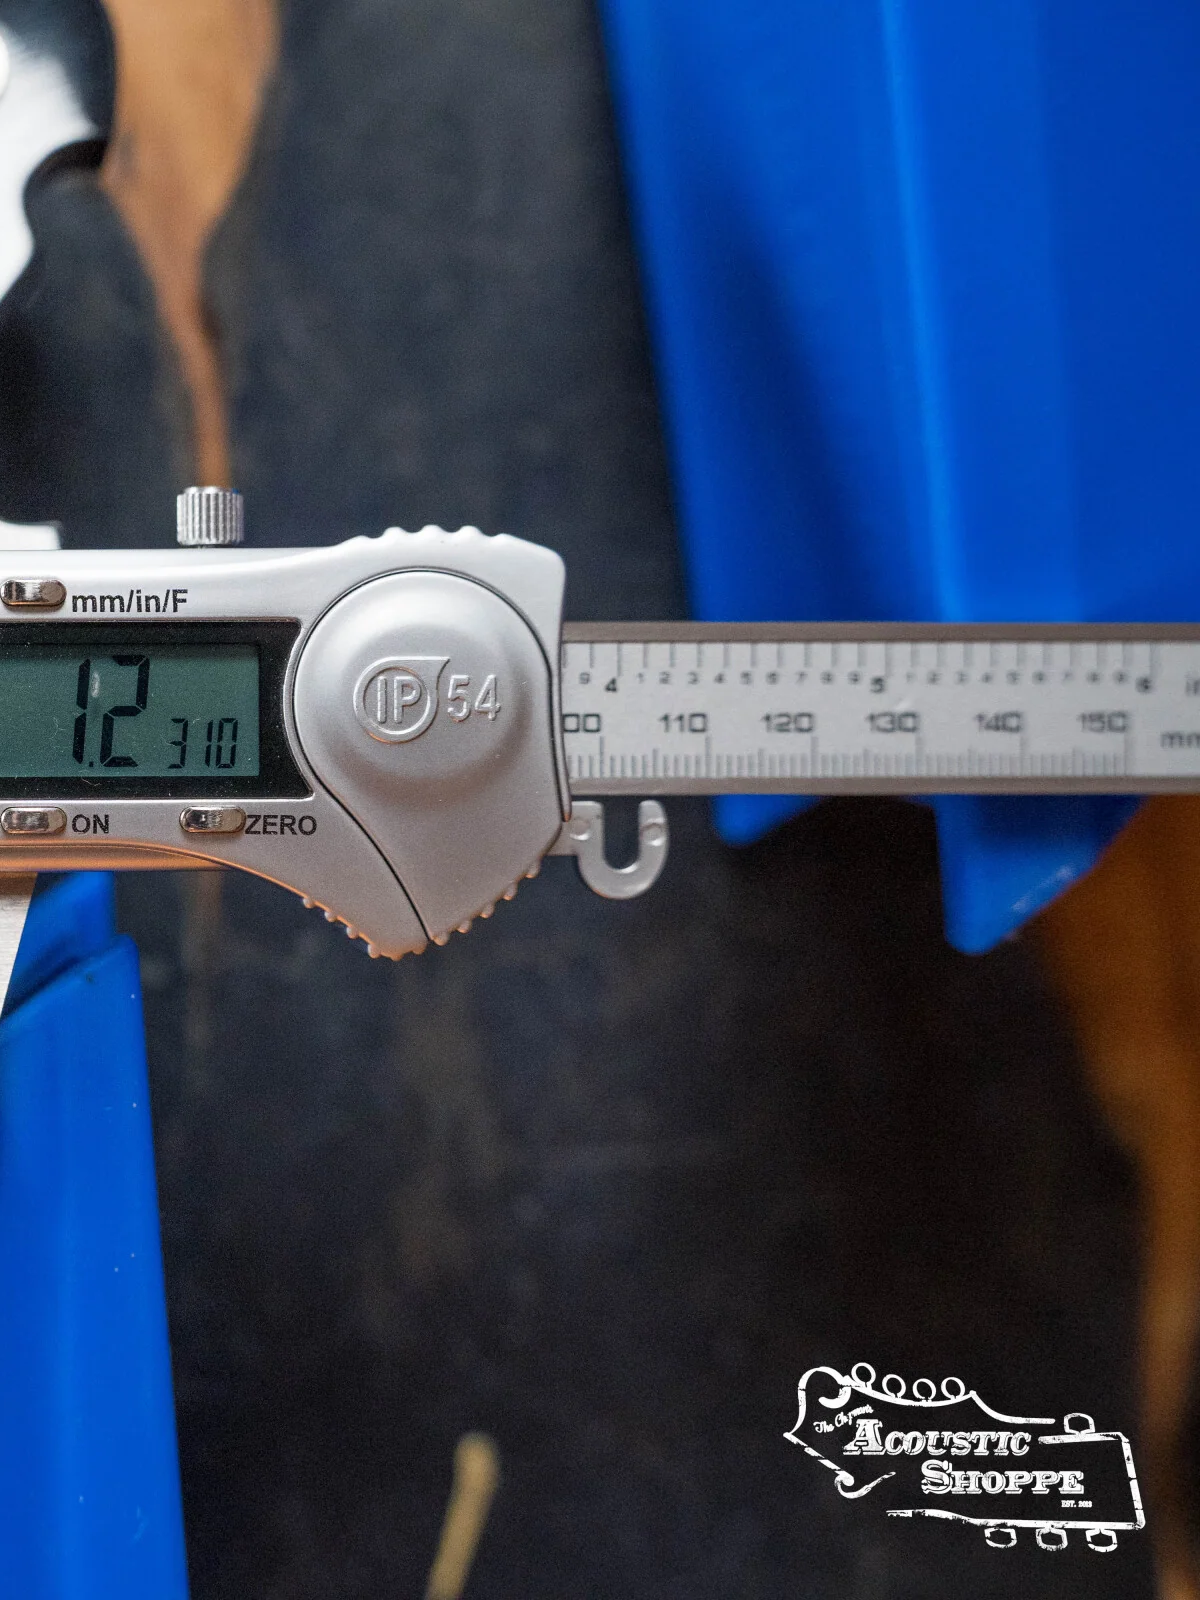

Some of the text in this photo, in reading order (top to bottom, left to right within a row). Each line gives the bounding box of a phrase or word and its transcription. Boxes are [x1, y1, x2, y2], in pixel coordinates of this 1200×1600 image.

[72, 589, 188, 614] mm/in/F
[579, 672, 591, 685] 9
[604, 677, 618, 693] 4
[659, 671, 671, 685] 2
[687, 671, 699, 685] 3
[871, 676, 885, 694] 5
[377, 674, 501, 724] IP 54
[659, 712, 708, 734] 110
[761, 711, 815, 734] 120
[865, 710, 920, 734] 130
[975, 710, 1025, 734] 140
[1078, 710, 1131, 734] 150
[71, 813, 111, 837] ON
[244, 813, 318, 837] ZERO
